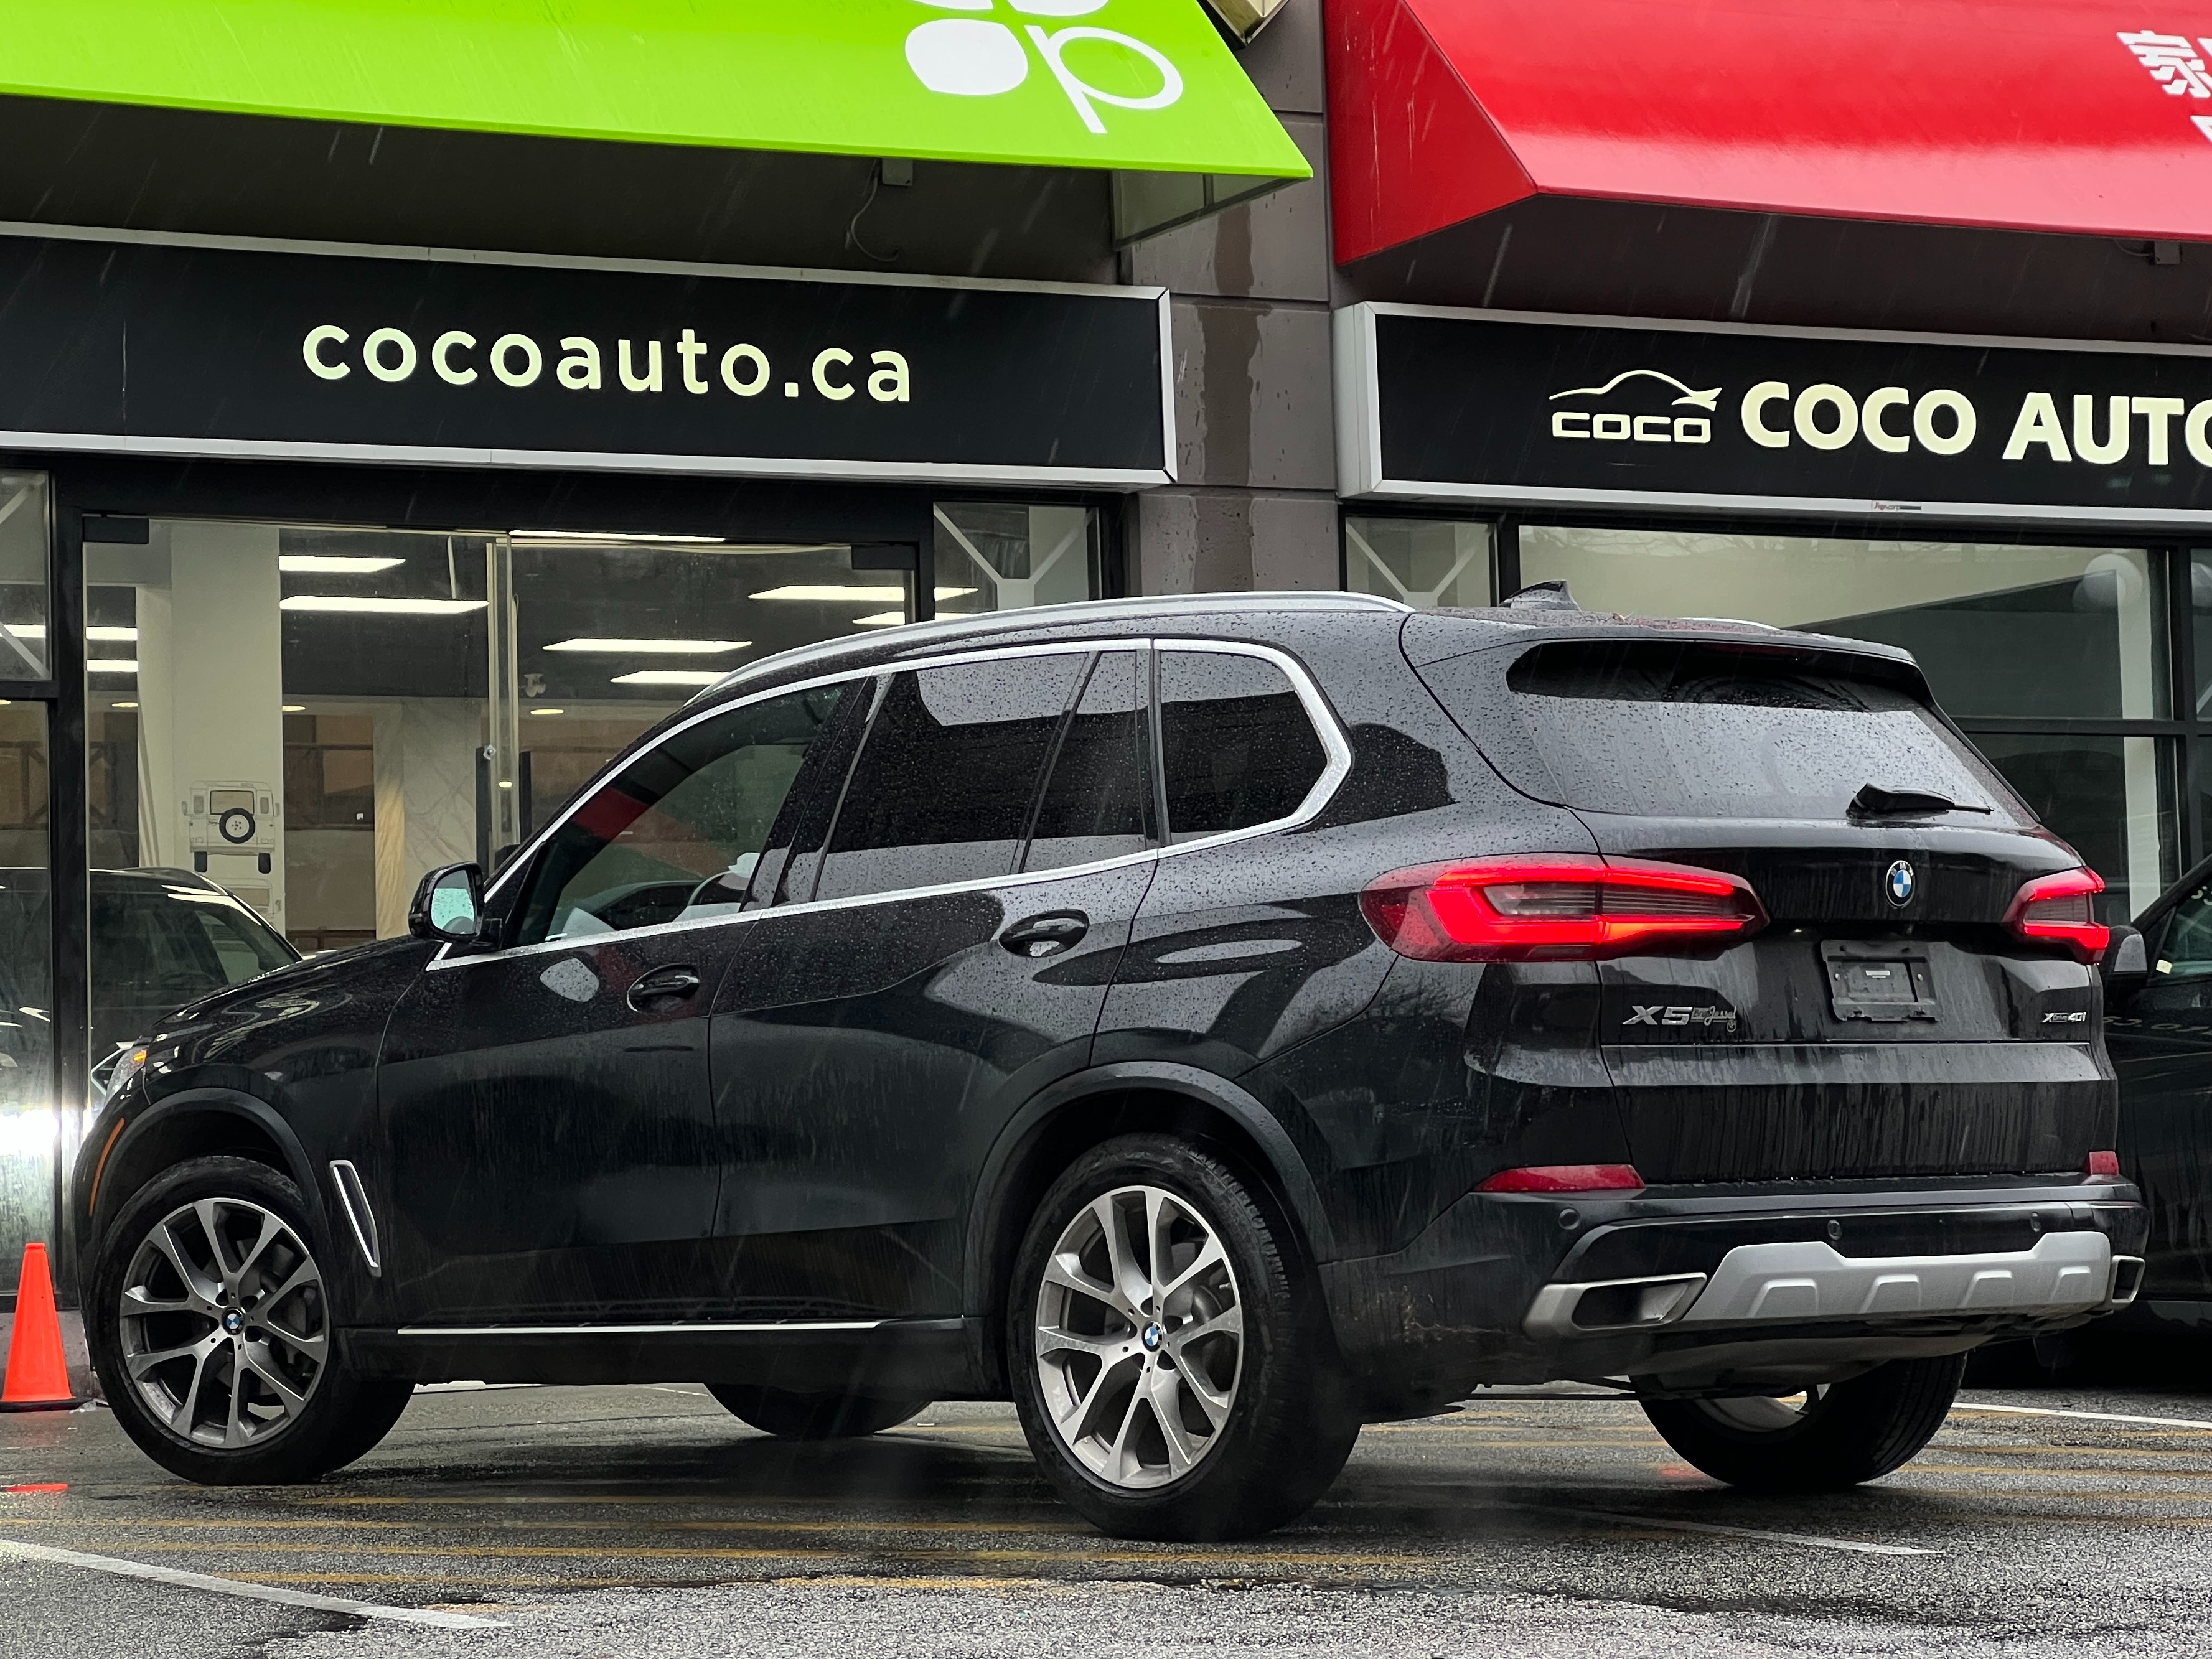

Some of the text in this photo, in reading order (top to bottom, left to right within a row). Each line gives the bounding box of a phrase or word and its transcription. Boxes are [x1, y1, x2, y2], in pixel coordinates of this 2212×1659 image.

[2116, 30, 2212, 98] 家
[302, 325, 910, 402] cocoauto.ca
[1552, 411, 1711, 444] COCO
[1741, 381, 1977, 455] COCO
[1622, 1006, 1693, 1026] X5
